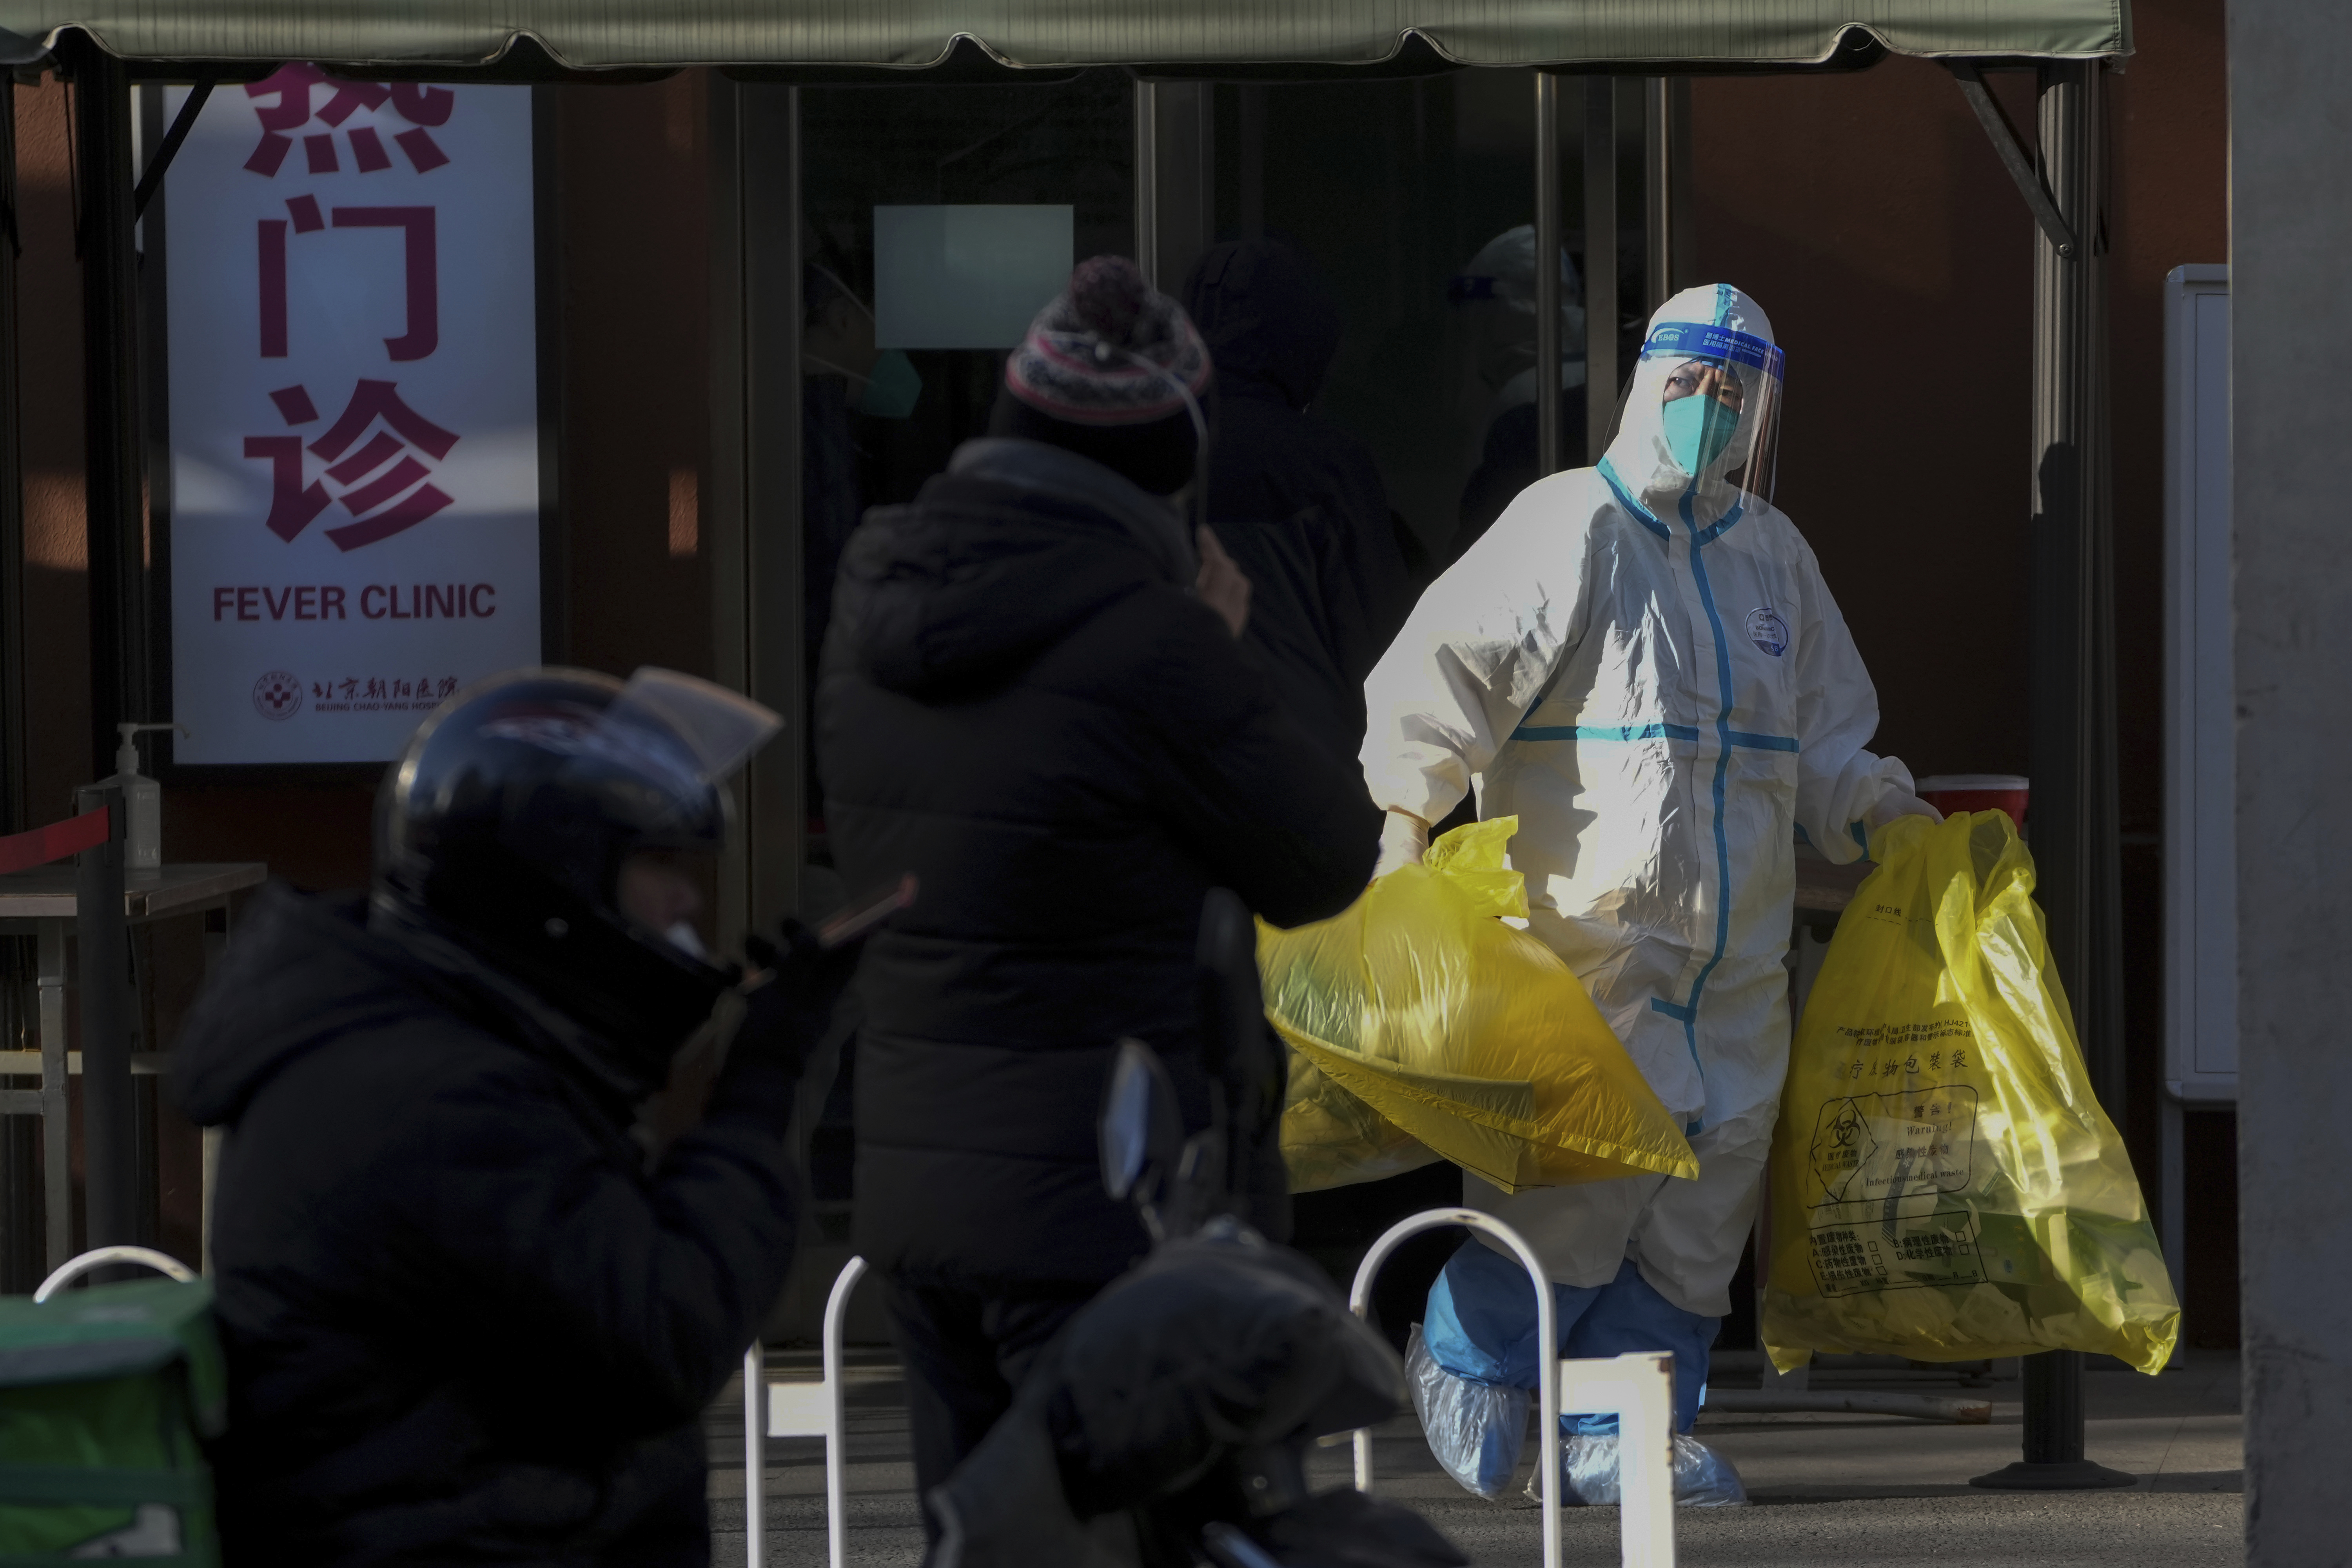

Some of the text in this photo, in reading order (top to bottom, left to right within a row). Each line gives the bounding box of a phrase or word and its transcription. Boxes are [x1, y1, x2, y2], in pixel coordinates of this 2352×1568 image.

[213, 584, 496, 621] FEVER CLINIC
[315, 703, 350, 712] BEIJING
[412, 702, 439, 710] HOSP
[1875, 904, 1901, 917] 封口线
[1835, 1049, 1967, 1079] 疗废物包装袋
[1907, 1122, 1952, 1136] Warning!
[1939, 1168, 1965, 1178] waste
